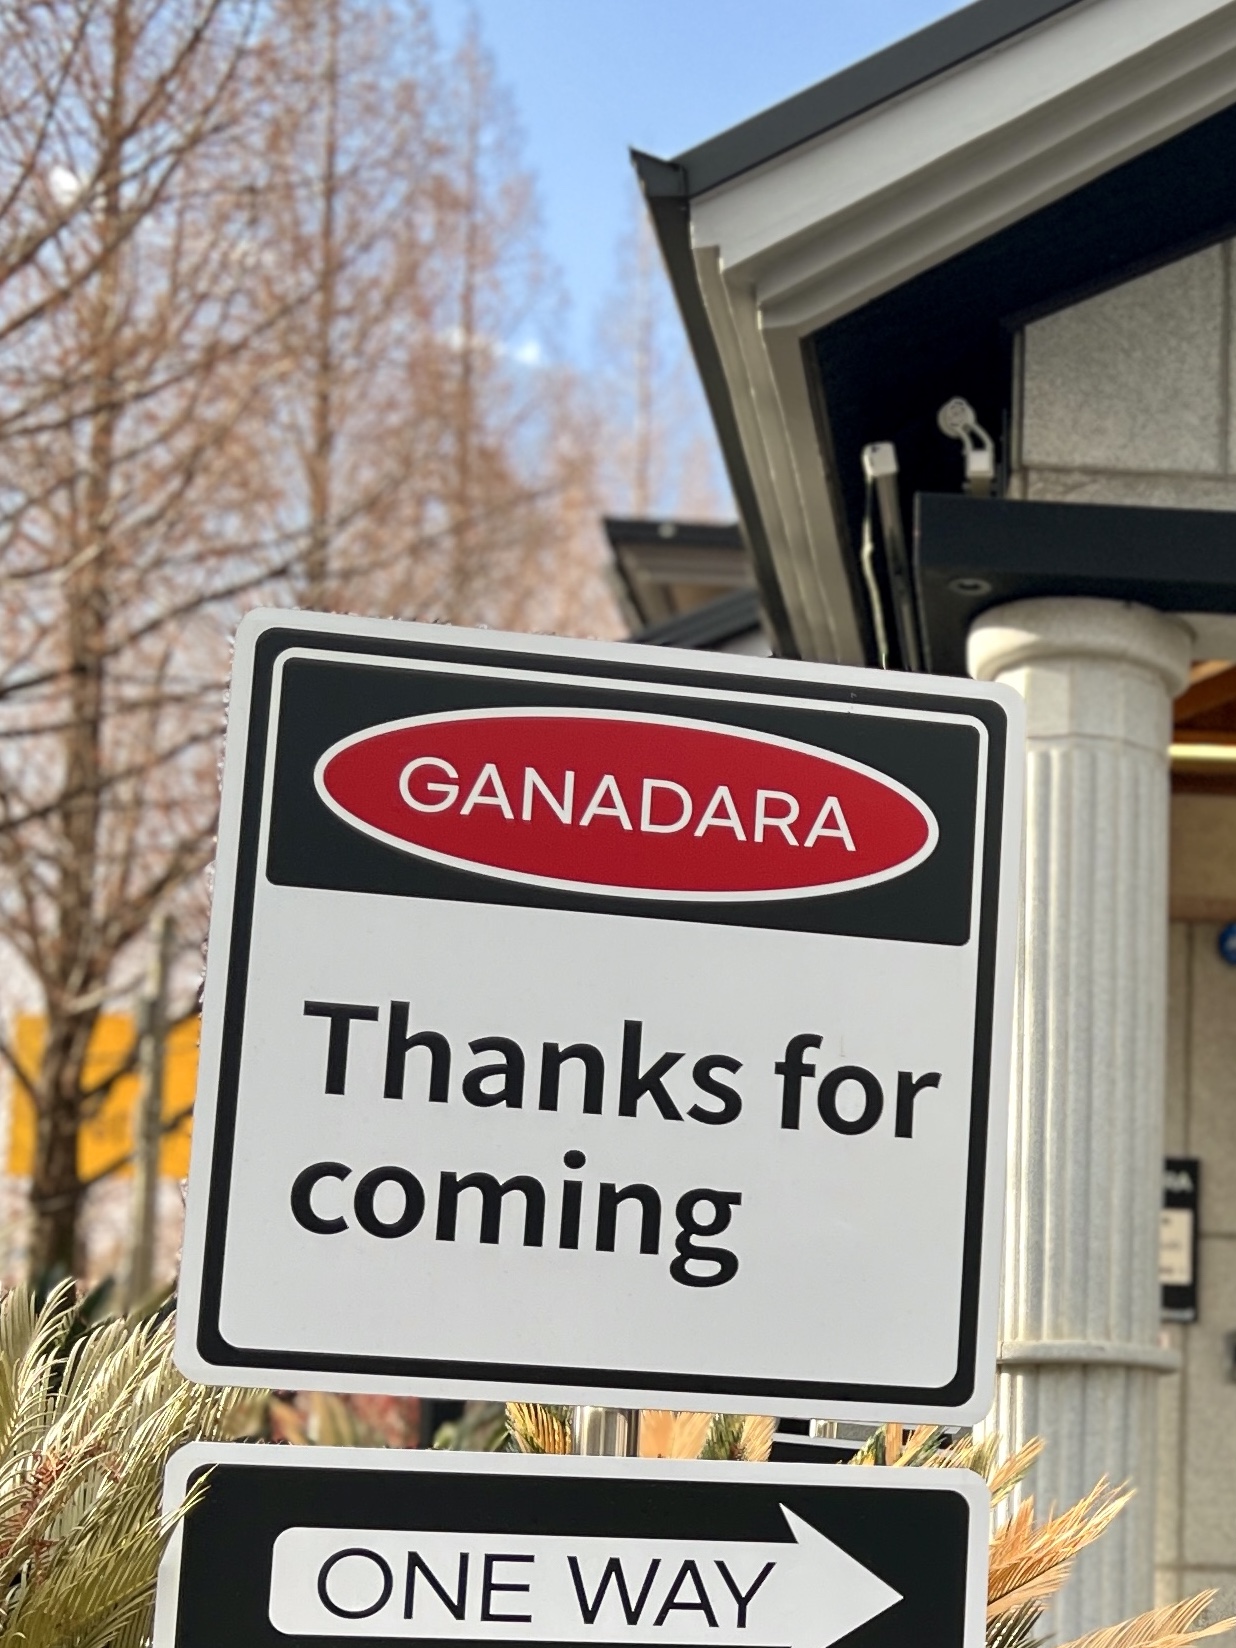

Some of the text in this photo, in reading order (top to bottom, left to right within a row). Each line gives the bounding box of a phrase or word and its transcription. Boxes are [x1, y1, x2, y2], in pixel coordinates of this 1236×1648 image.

[399, 756, 856, 852] GANADARA
[303, 1000, 942, 1139] Thanks for
[290, 1149, 742, 1288] coming
[317, 1547, 776, 1629] ONE WAY
